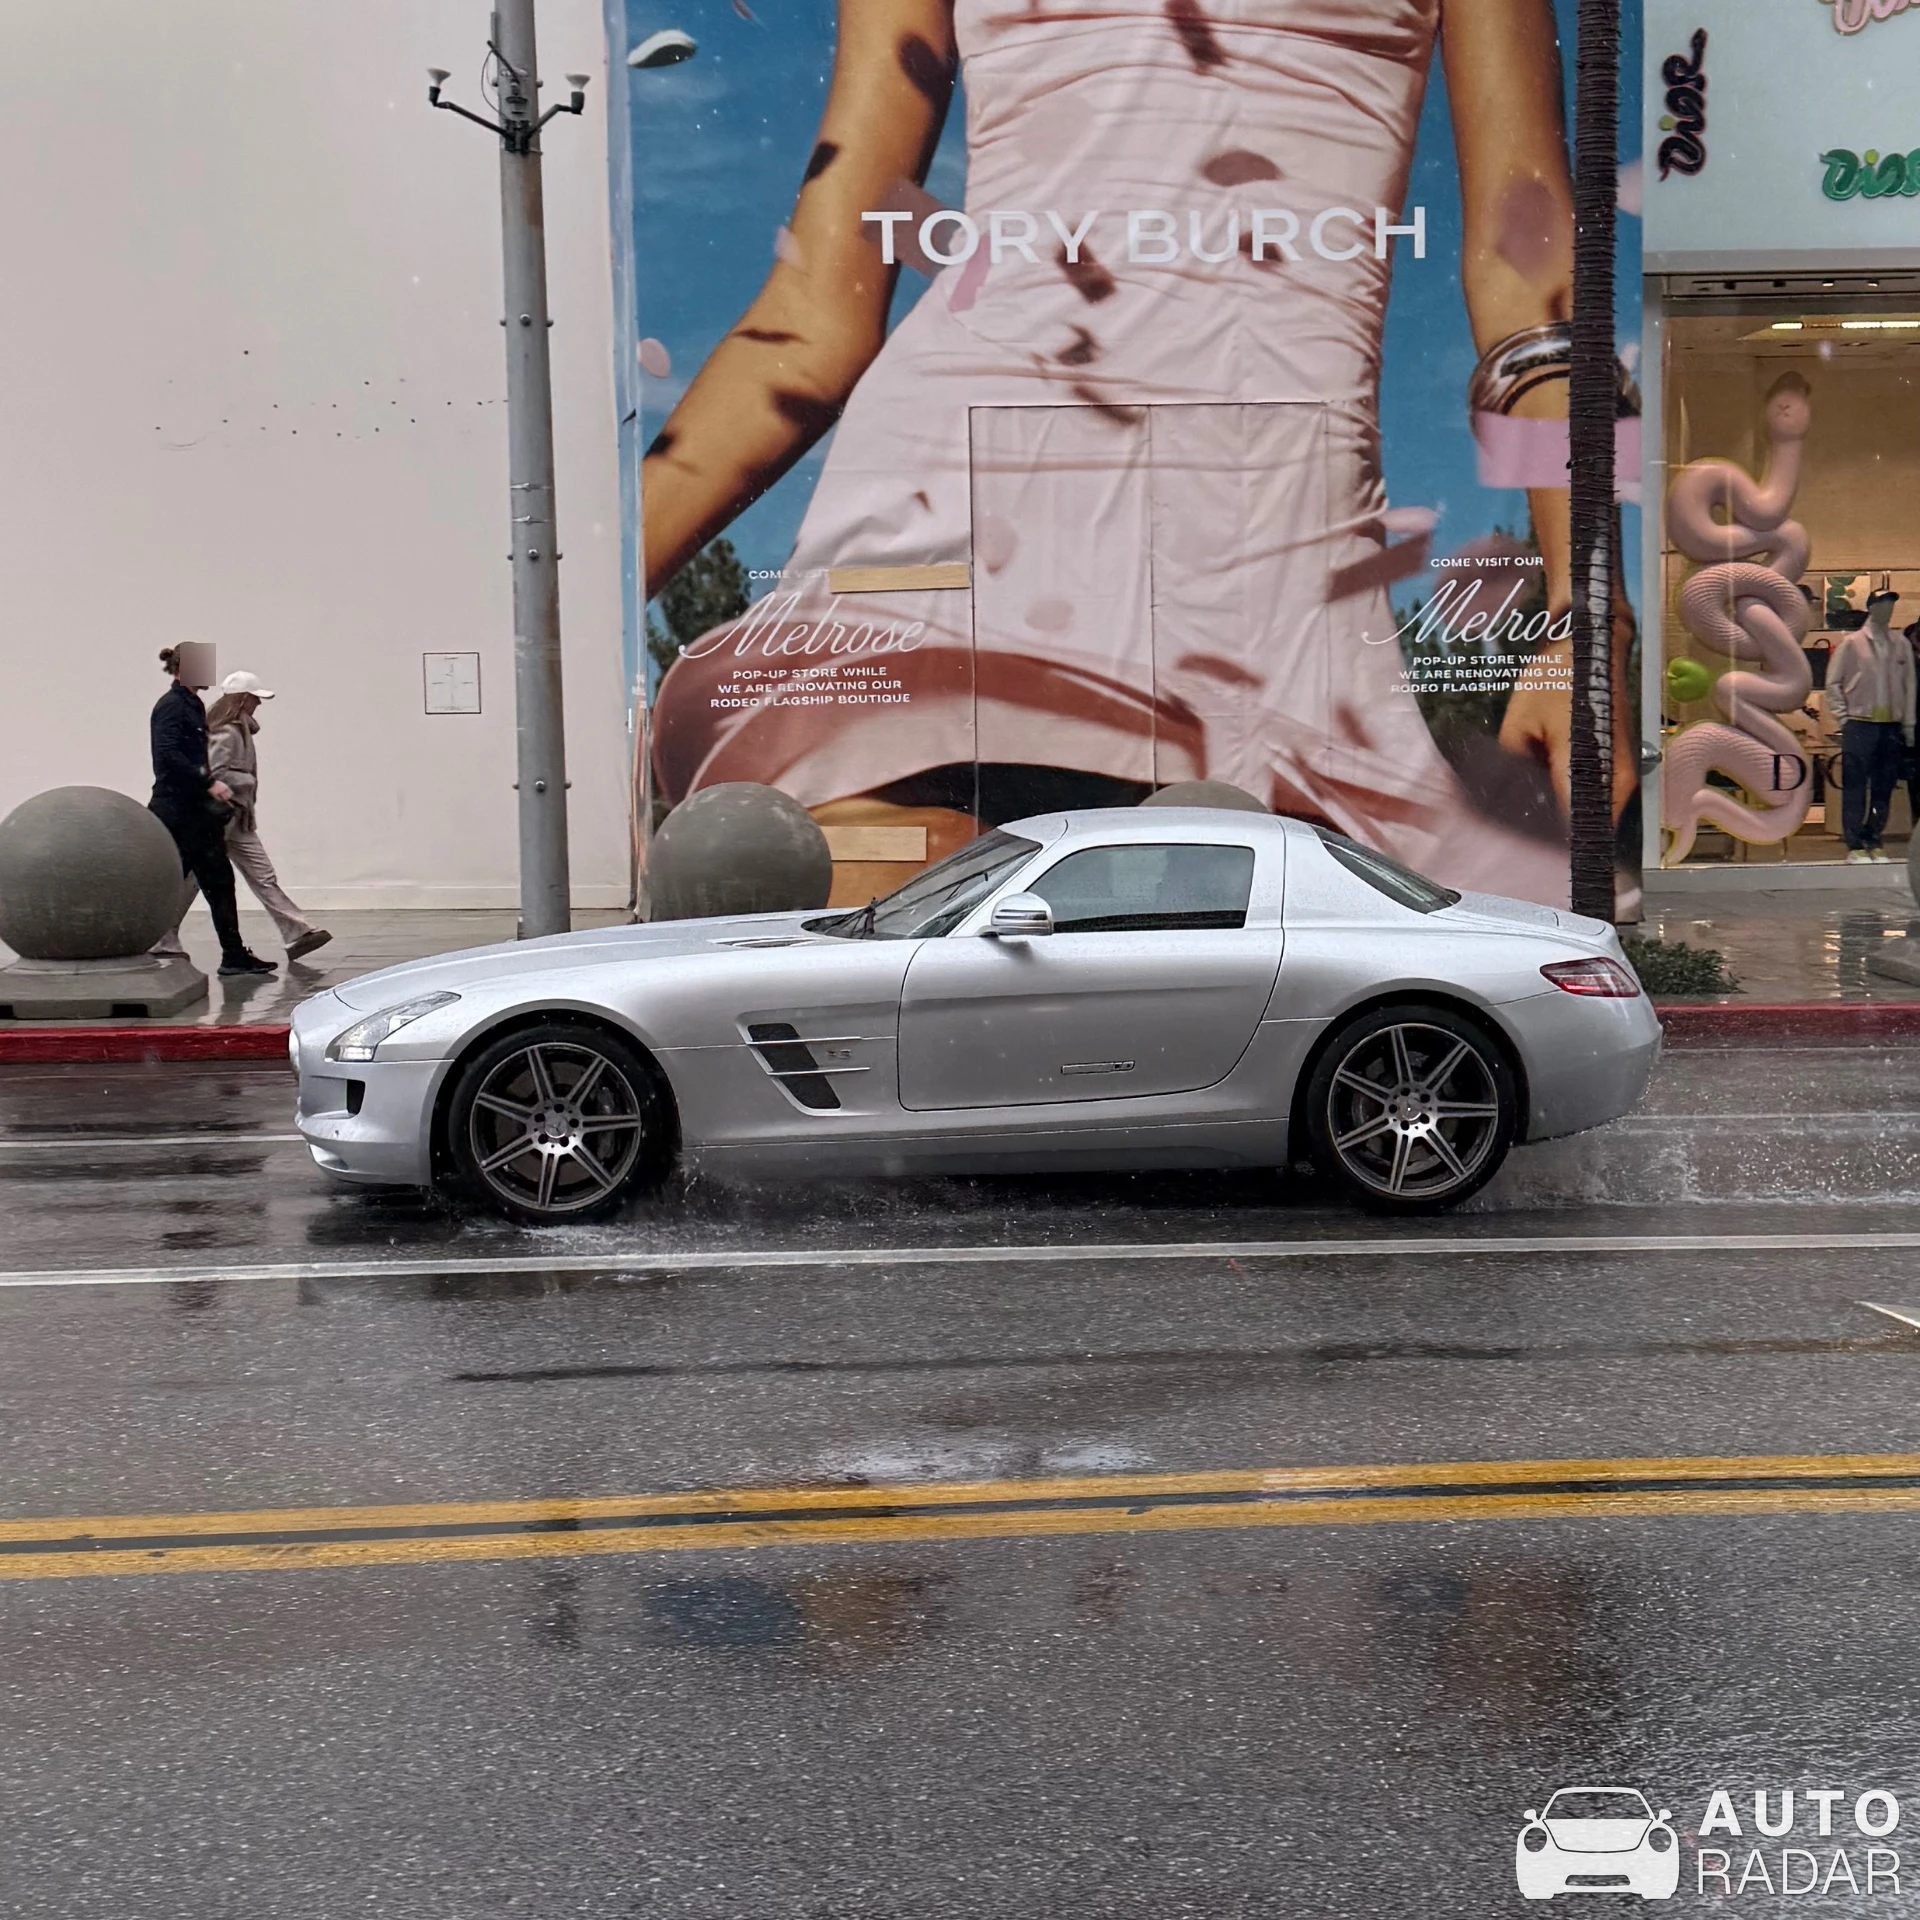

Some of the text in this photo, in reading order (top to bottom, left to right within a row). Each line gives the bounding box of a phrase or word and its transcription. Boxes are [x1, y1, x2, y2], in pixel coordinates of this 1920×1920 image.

[1657, 27, 1708, 183] Dior
[861, 206, 1426, 265] TORY BURCH
[1430, 556, 1544, 568] COME VISIT OUR
[1361, 577, 1573, 645] Melros
[678, 591, 926, 658] Melrose
[1413, 654, 1563, 667] POP-UP STORE WHILE
[732, 666, 888, 680] POP-UP STORE WHILE
[1400, 669, 1420, 680] WE
[1424, 669, 1452, 680] ARE
[1455, 668, 1543, 679] RENOVATING
[717, 680, 902, 695] WE ARE RENOVATING OUR
[1391, 683, 1438, 693] RODEO
[1442, 682, 1510, 692] FLAGSHIP
[710, 694, 911, 709] RODEO FLAGSHIP BOUTIQUE
